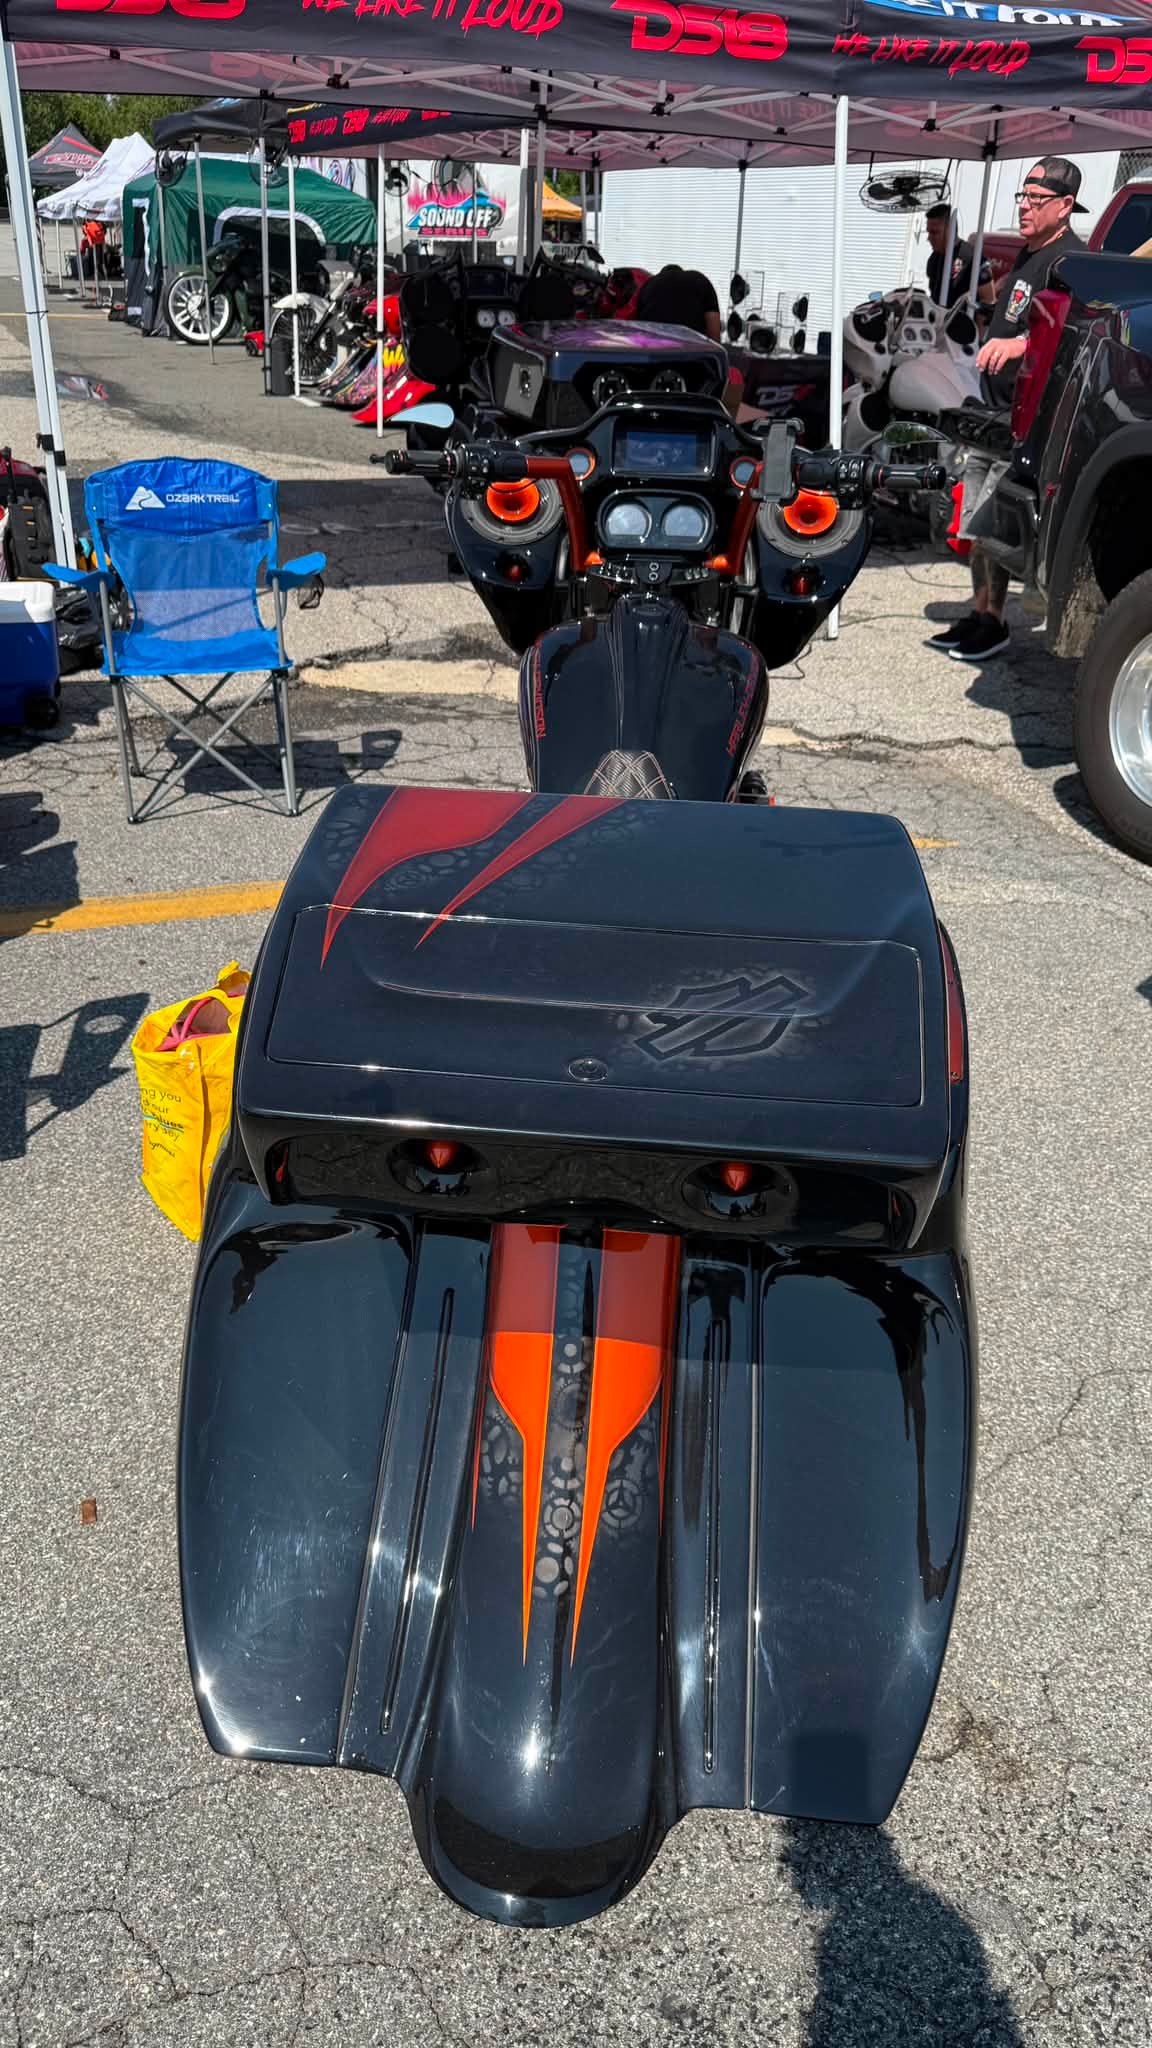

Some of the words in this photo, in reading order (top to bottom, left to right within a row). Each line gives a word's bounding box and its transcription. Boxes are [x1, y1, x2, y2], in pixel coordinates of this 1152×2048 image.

[609, 0, 788, 61] DS18
[832, 33, 871, 54] WE
[872, 36, 929, 63] LIKE
[928, 39, 953, 64] IT
[949, 39, 1031, 79] LOUD
[419, 208, 465, 228] SOUND
[466, 208, 492, 228] OFF
[166, 493, 205, 503] OZARK
[206, 493, 240, 503] TRAIL
[160, 1091, 181, 1103] you
